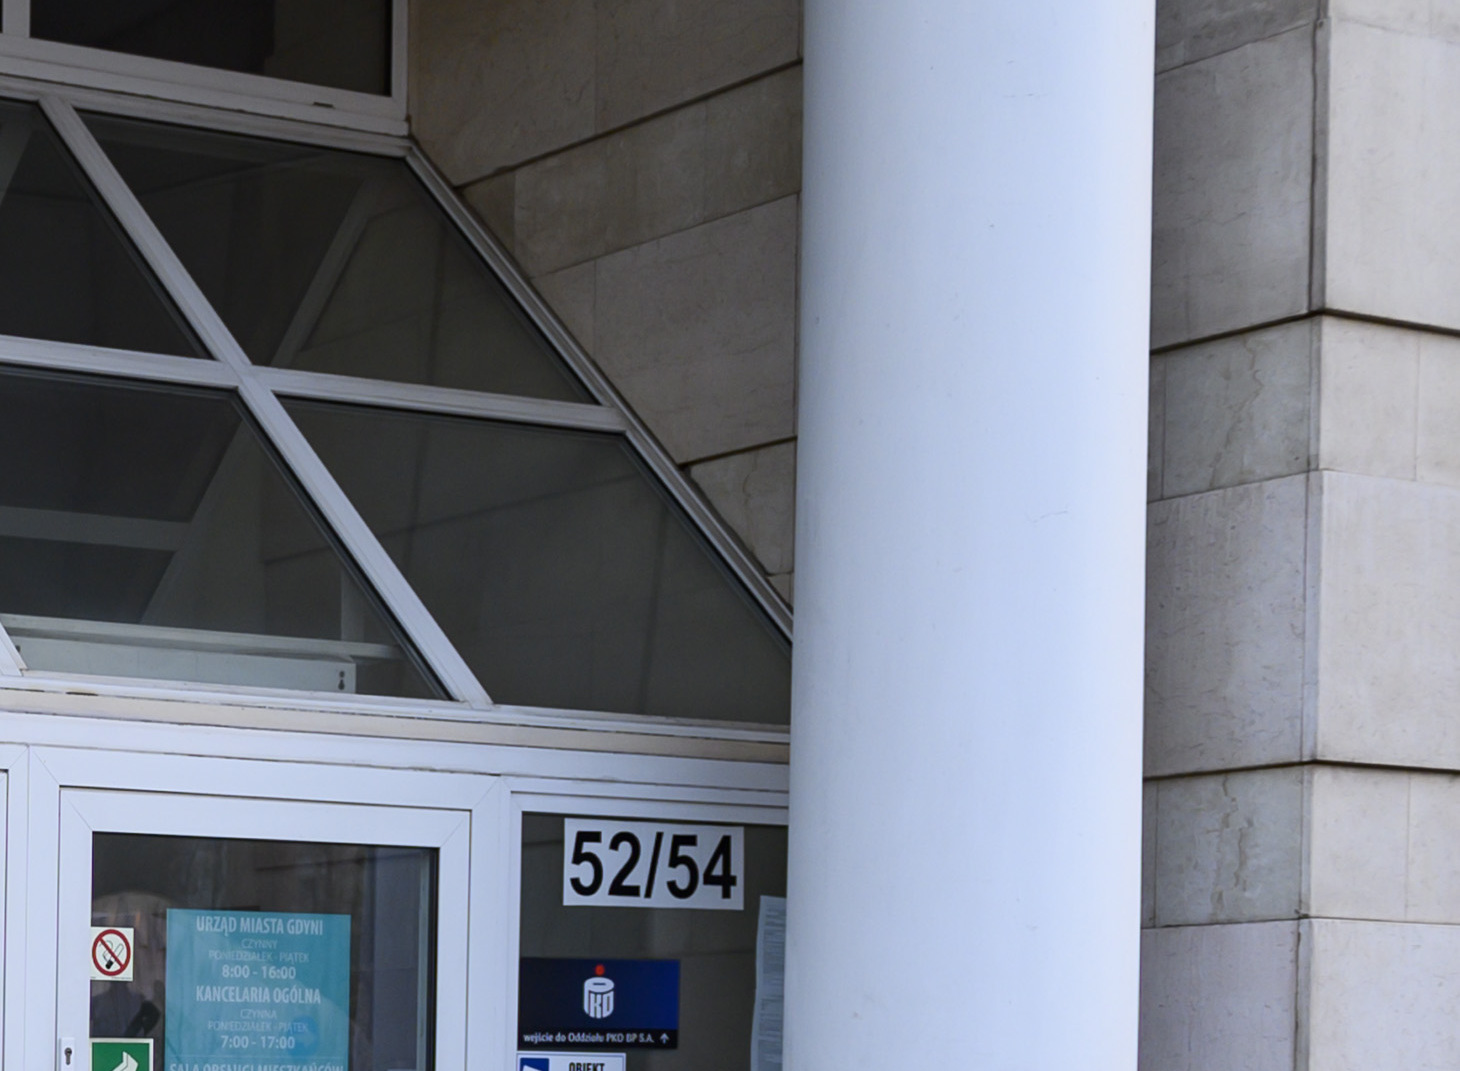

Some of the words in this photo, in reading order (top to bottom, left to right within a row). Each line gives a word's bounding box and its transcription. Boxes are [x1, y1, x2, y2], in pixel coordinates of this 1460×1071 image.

[569, 830, 738, 899] 52/54
[196, 916, 237, 937] URZĄD
[240, 917, 284, 934] MIASTA
[287, 919, 324, 935] GDYNI
[241, 938, 278, 949] CZYNNY
[208, 951, 273, 962] PONIEDZIAŁEK
[280, 952, 309, 964] PIĄTEK
[222, 964, 250, 979] 8:00
[261, 966, 296, 979] 16:00
[196, 985, 271, 1003] KANCELARIA
[273, 985, 321, 1004] OGÓLNA
[240, 1008, 278, 1020] CZYNNA
[221, 1035, 249, 1049] 7:00
[261, 1036, 296, 1049] 17:00
[555, 1032, 566, 1043] do
[567, 1032, 605, 1043] Oddziału
[606, 1033, 624, 1043] PKO
